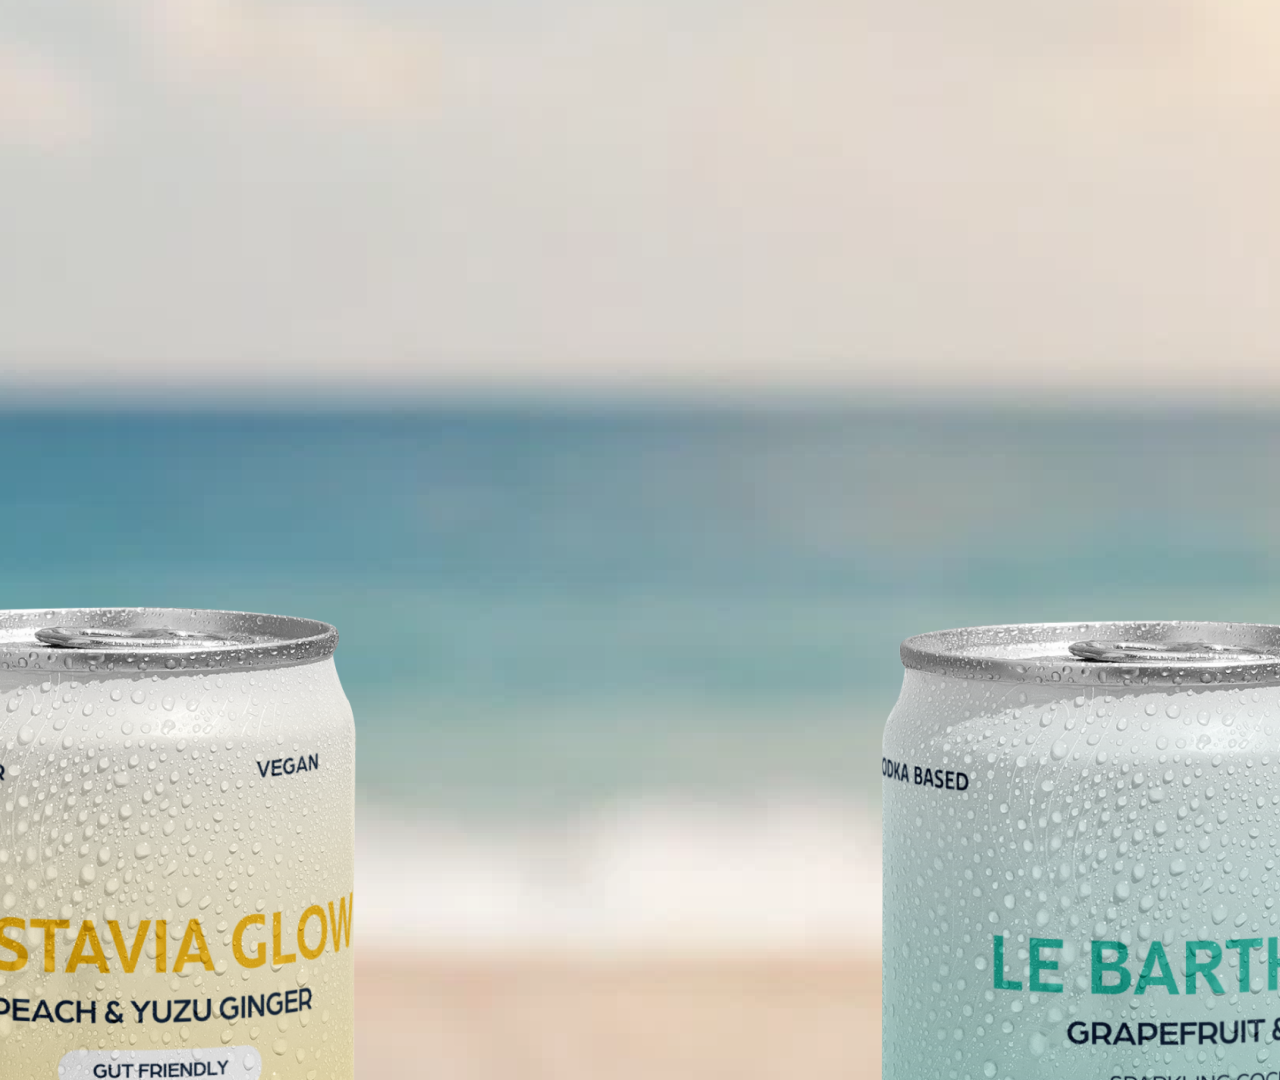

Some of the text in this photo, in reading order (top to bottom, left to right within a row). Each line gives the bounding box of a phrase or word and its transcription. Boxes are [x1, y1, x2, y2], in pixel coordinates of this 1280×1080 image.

[257, 753, 319, 779] VEGAN
[914, 765, 969, 791] BASED
[232, 891, 353, 969] GLOW
[992, 935, 1064, 994] LE
[104, 1001, 124, 1024] &
[130, 999, 212, 1024] YUZU
[219, 987, 313, 1021] GINGER
[1066, 1019, 1265, 1046] GRAPEFRUIT
[93, 1060, 229, 1080] GUT FRIENDLY
